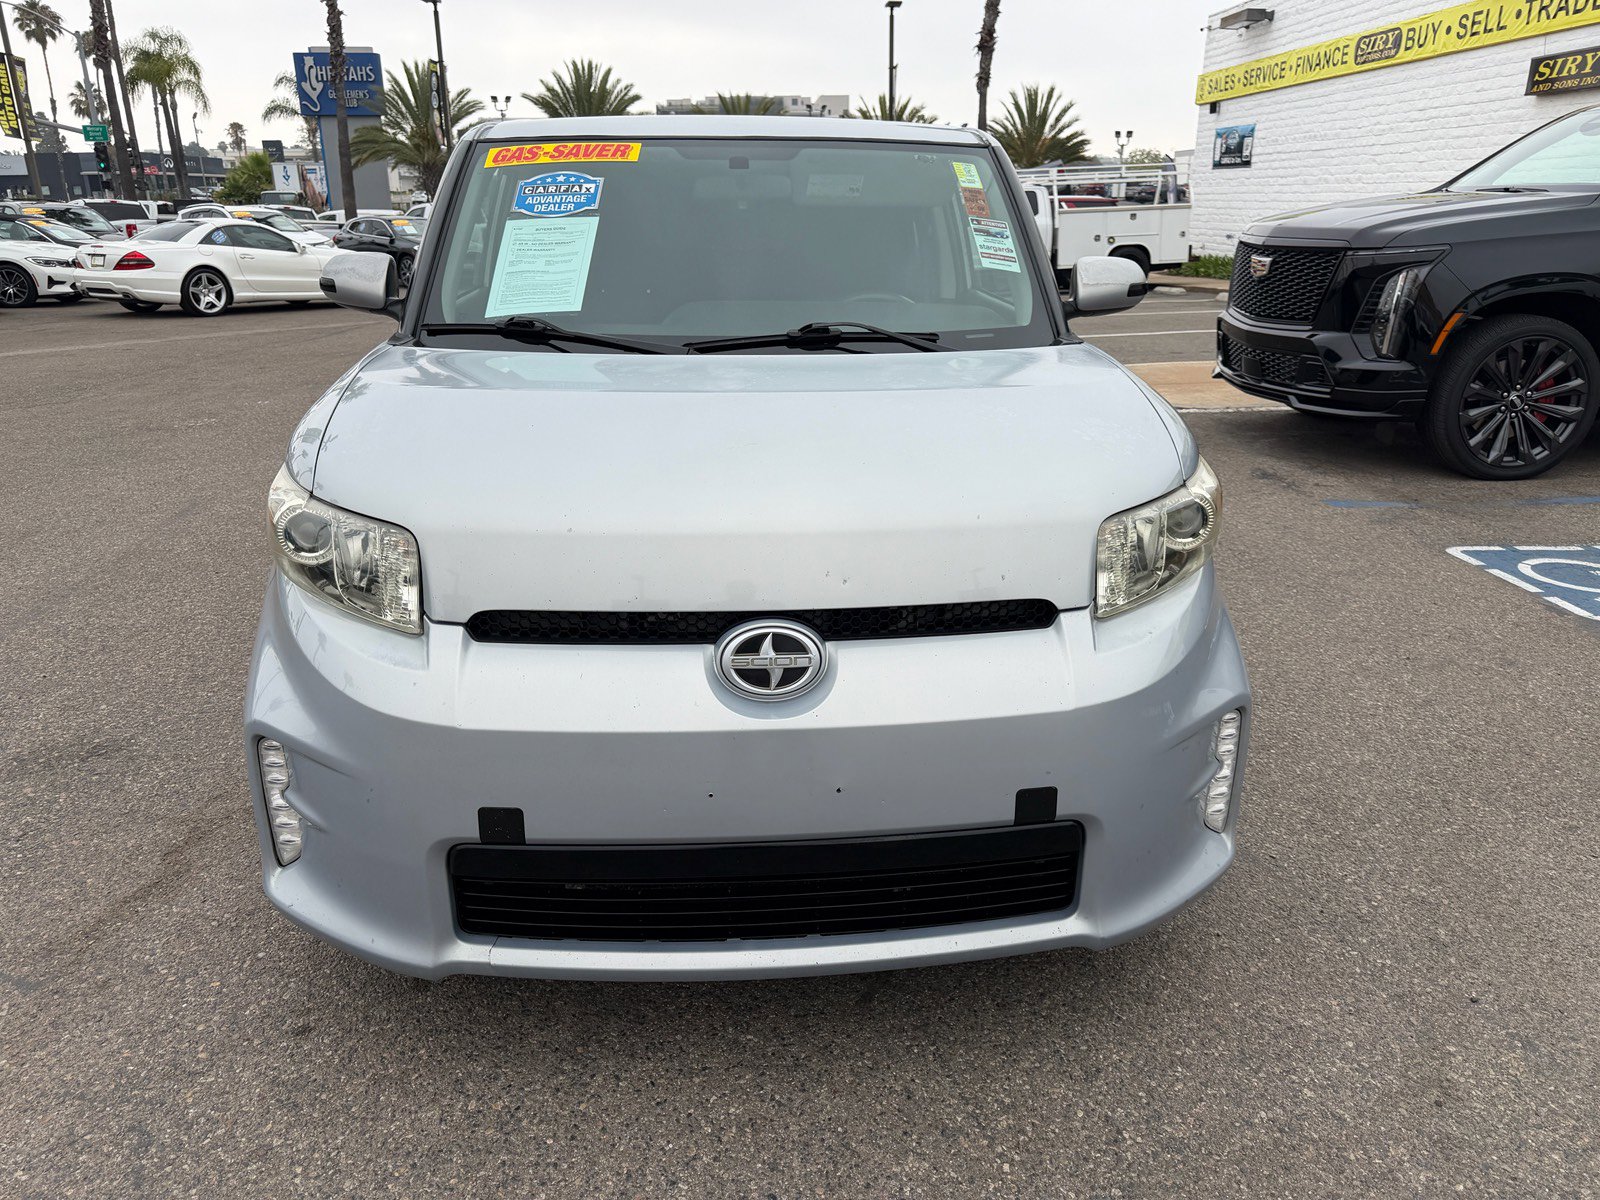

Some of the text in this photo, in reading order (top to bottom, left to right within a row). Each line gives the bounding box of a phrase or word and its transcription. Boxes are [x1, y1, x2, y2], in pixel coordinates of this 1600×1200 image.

[1404, 20, 1443, 51] BUY
[1456, 5, 1508, 40] SELL
[1357, 30, 1401, 55] SIRY
[1207, 74, 1235, 95] SALES
[1242, 61, 1287, 87] SERVICE
[1294, 44, 1350, 76] FINANCE
[1533, 51, 1600, 81] SIRY
[328, 89, 370, 99] GELEMEN'S
[1530, 83, 1552, 93] AND
[1552, 79, 1579, 90] SONS
[3, 96, 18, 129] AUTO
[492, 143, 633, 165] GAS-SAVER
[522, 183, 596, 195] CARFAX
[525, 195, 588, 205] ADVANTAGE
[534, 203, 575, 212] DEALER
